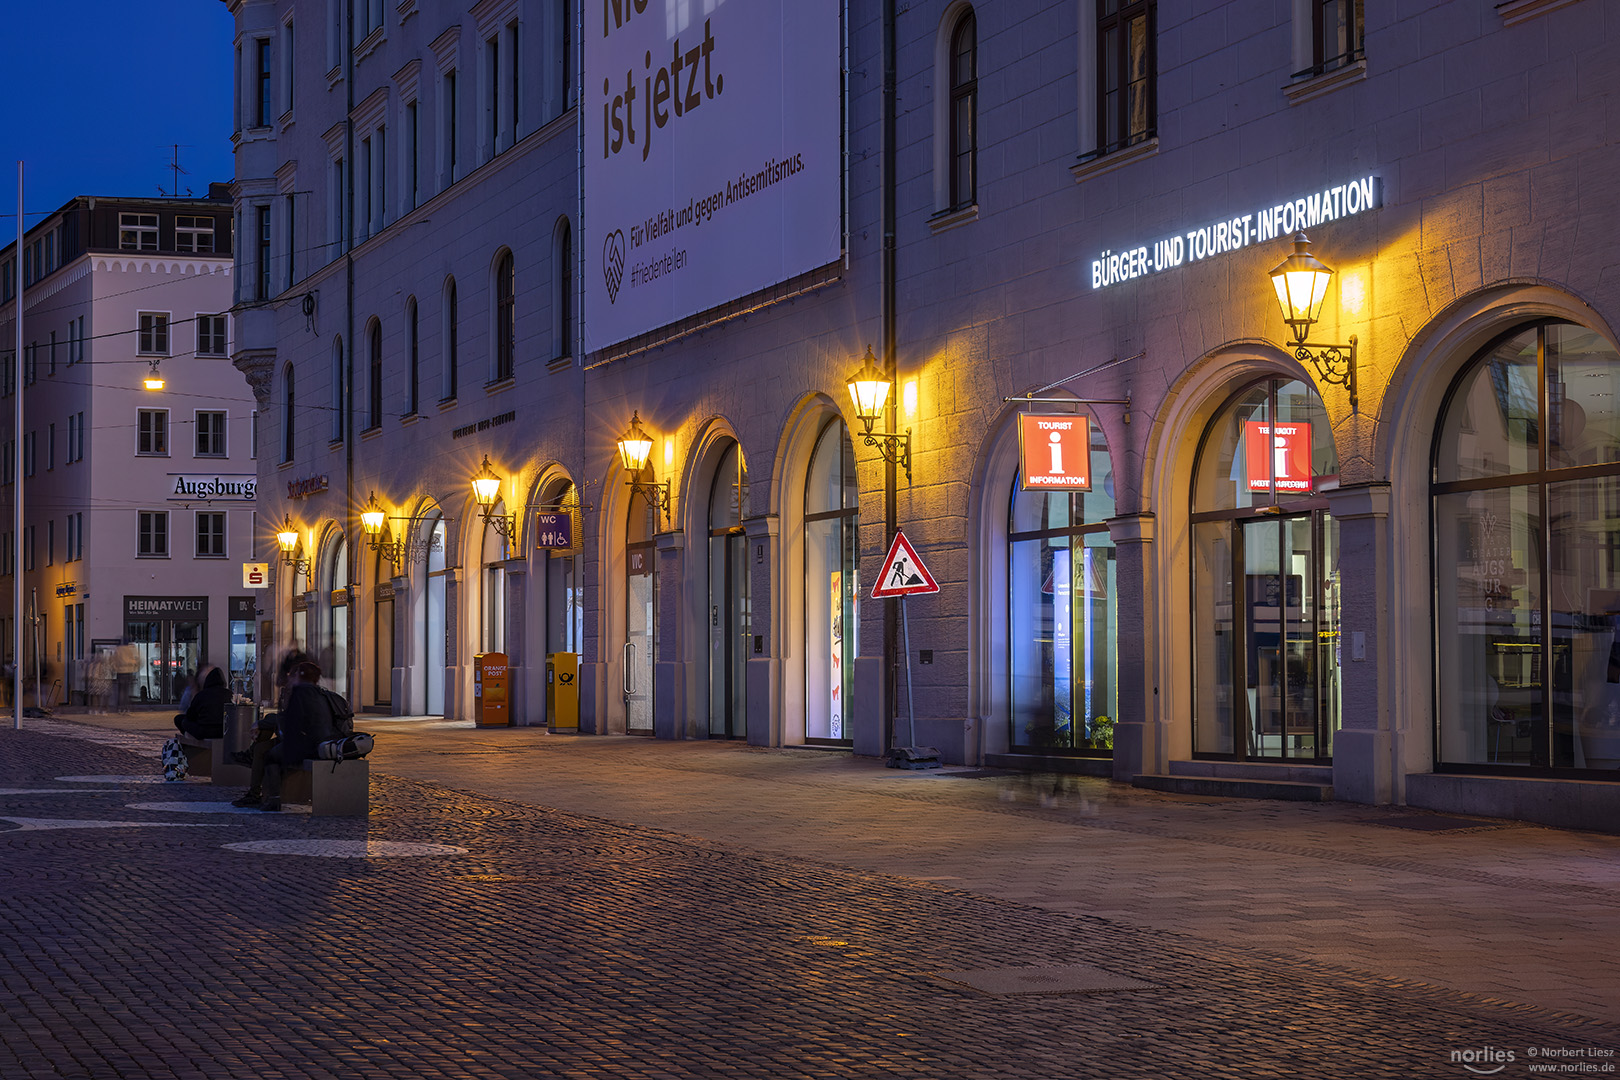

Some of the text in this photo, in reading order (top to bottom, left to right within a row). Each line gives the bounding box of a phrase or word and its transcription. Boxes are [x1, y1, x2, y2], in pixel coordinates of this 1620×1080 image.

[604, 17, 724, 163] ist jetzt.
[630, 153, 805, 250] Für Vielfalt und gegen Antisemitismus.
[1187, 175, 1374, 262] TOURIST-INFORMATION
[630, 246, 688, 289] #friedenteilen
[1037, 421, 1073, 430] TOURIST
[1029, 476, 1085, 485] INFORMATION
[541, 515, 557, 524] WC
[631, 552, 643, 570] WC
[1472, 559, 1505, 576] AUGS
[129, 600, 204, 611] HEIMATWELT
